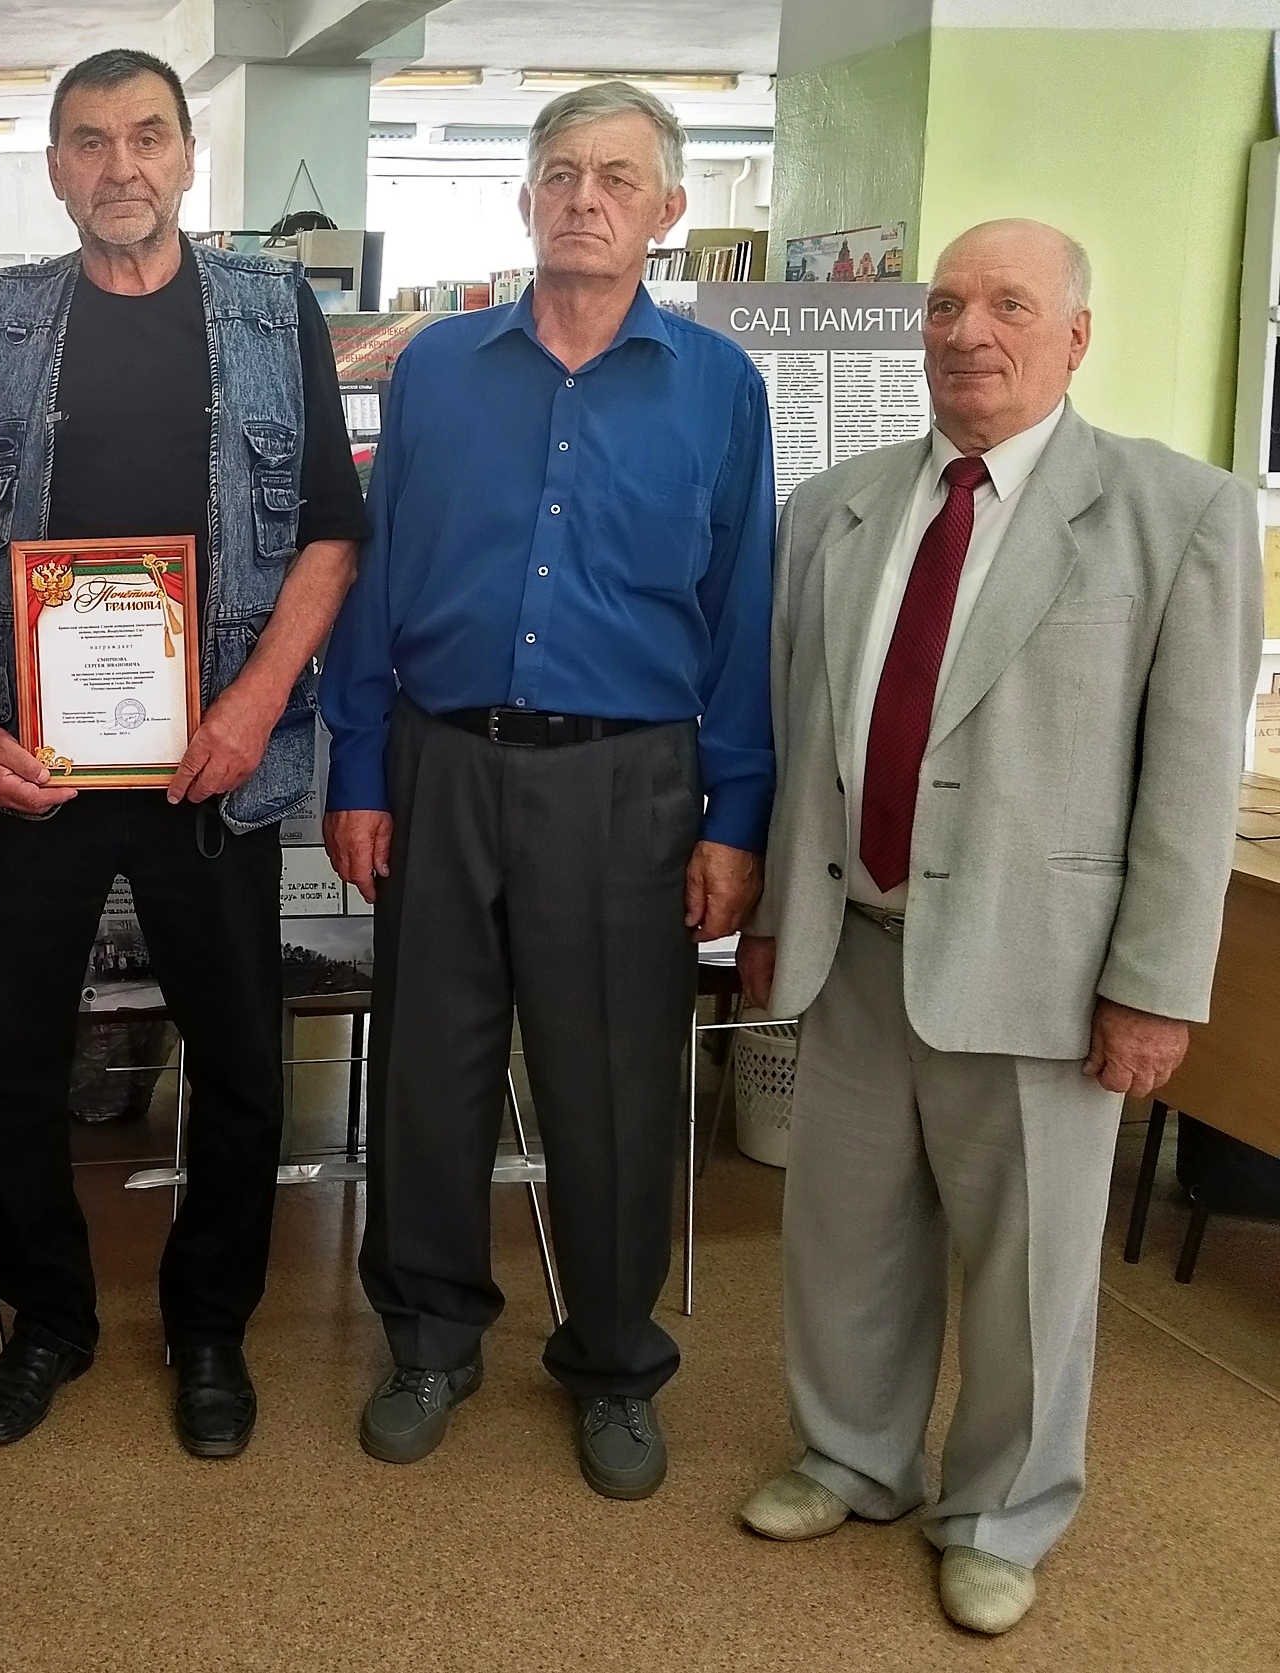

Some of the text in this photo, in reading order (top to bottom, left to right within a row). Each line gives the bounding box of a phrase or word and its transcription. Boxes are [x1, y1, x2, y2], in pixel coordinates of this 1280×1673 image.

[730, 307, 923, 337] САД ПАМЯТИ
[105, 600, 162, 612] ГРАМОТА
